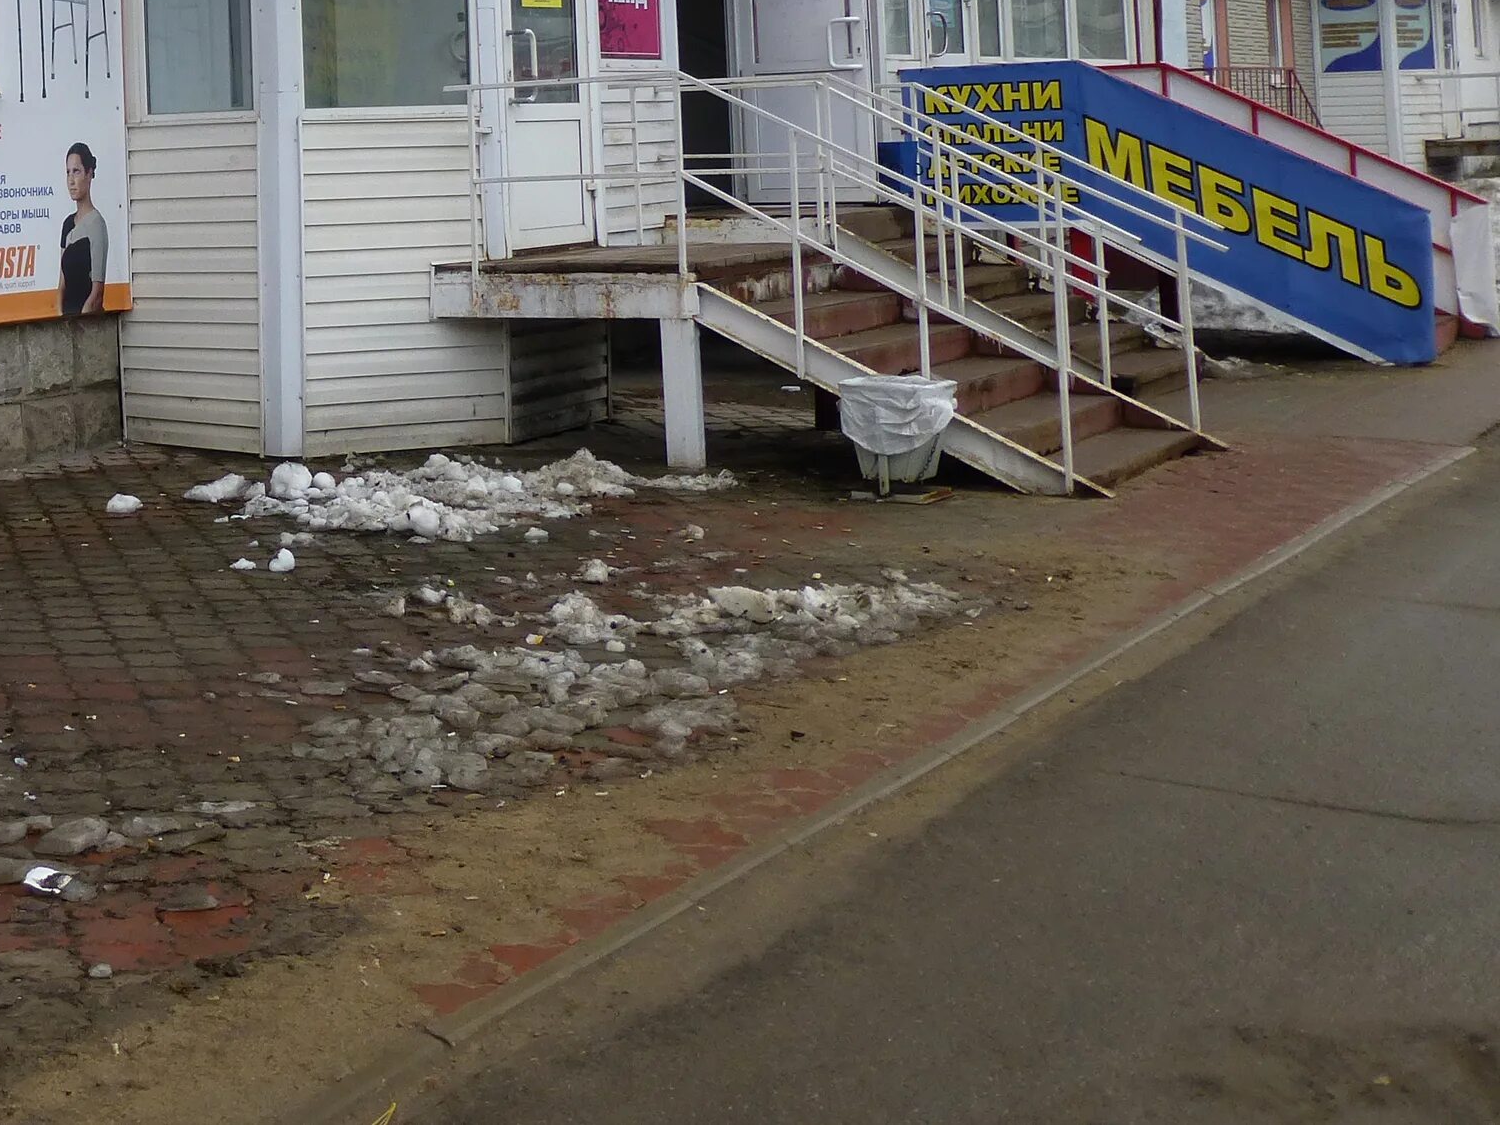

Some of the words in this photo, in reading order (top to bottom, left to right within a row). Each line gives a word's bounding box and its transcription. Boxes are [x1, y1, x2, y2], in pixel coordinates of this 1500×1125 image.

[924, 80, 1063, 114] КУХНИ
[22, 206, 50, 221] МЫШЦ
[1084, 115, 1422, 309] МЕБЕЛЬ
